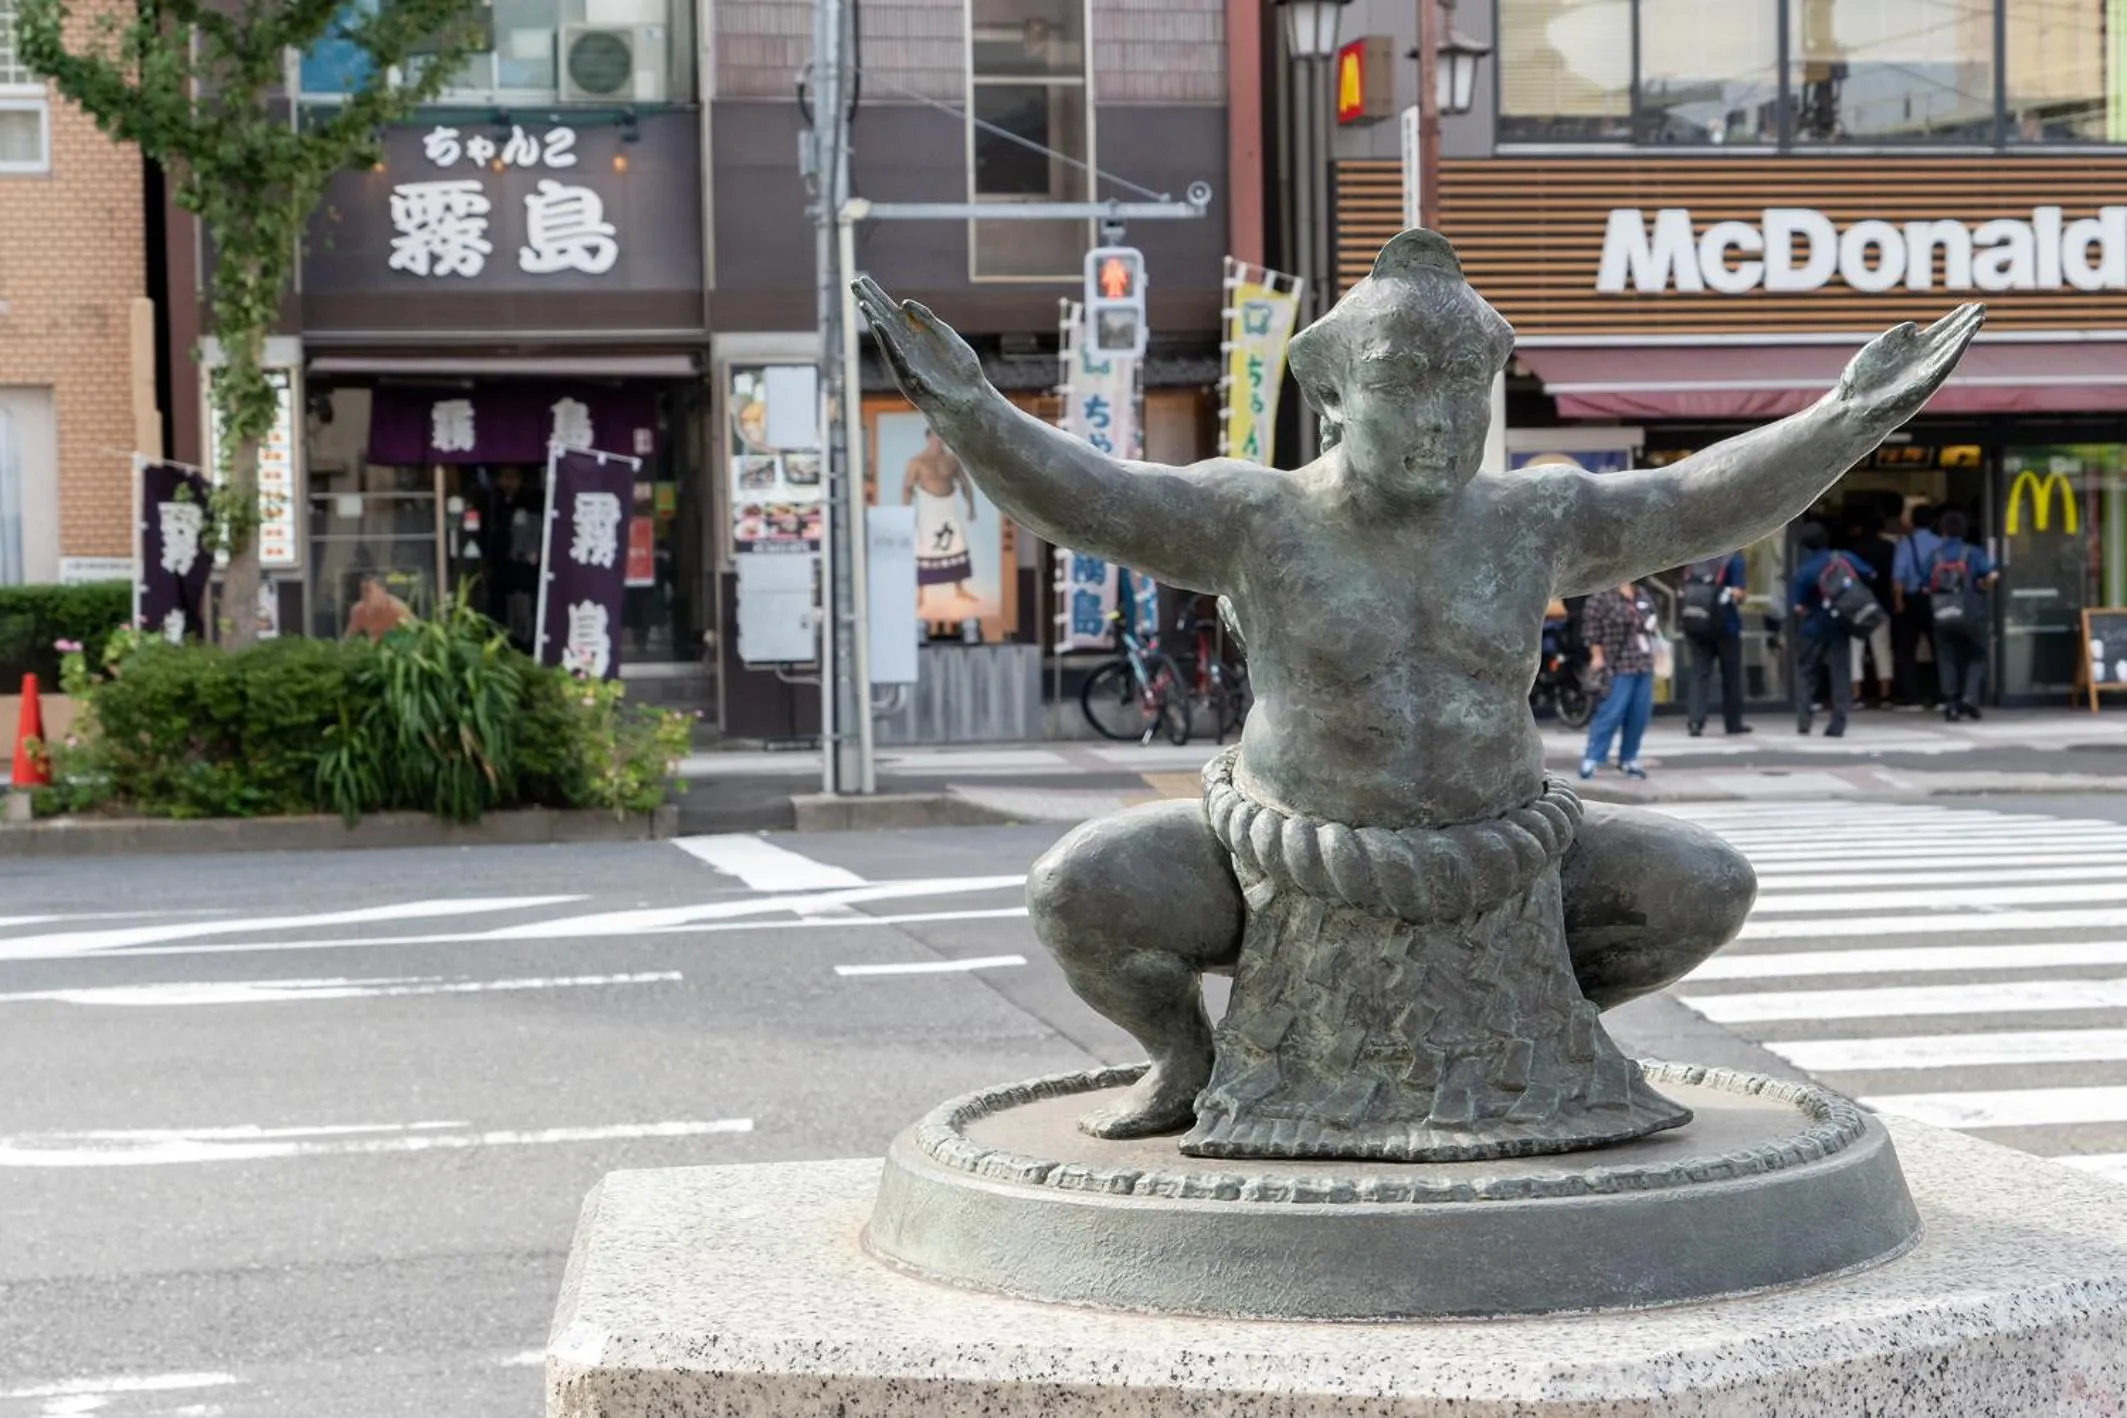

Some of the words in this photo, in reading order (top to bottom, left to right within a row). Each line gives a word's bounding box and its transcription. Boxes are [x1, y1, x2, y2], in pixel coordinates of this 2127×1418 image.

[423, 125, 577, 168] ちゃんこ
[388, 178, 619, 277] 霧島
[1597, 205, 2127, 294] McDonald
